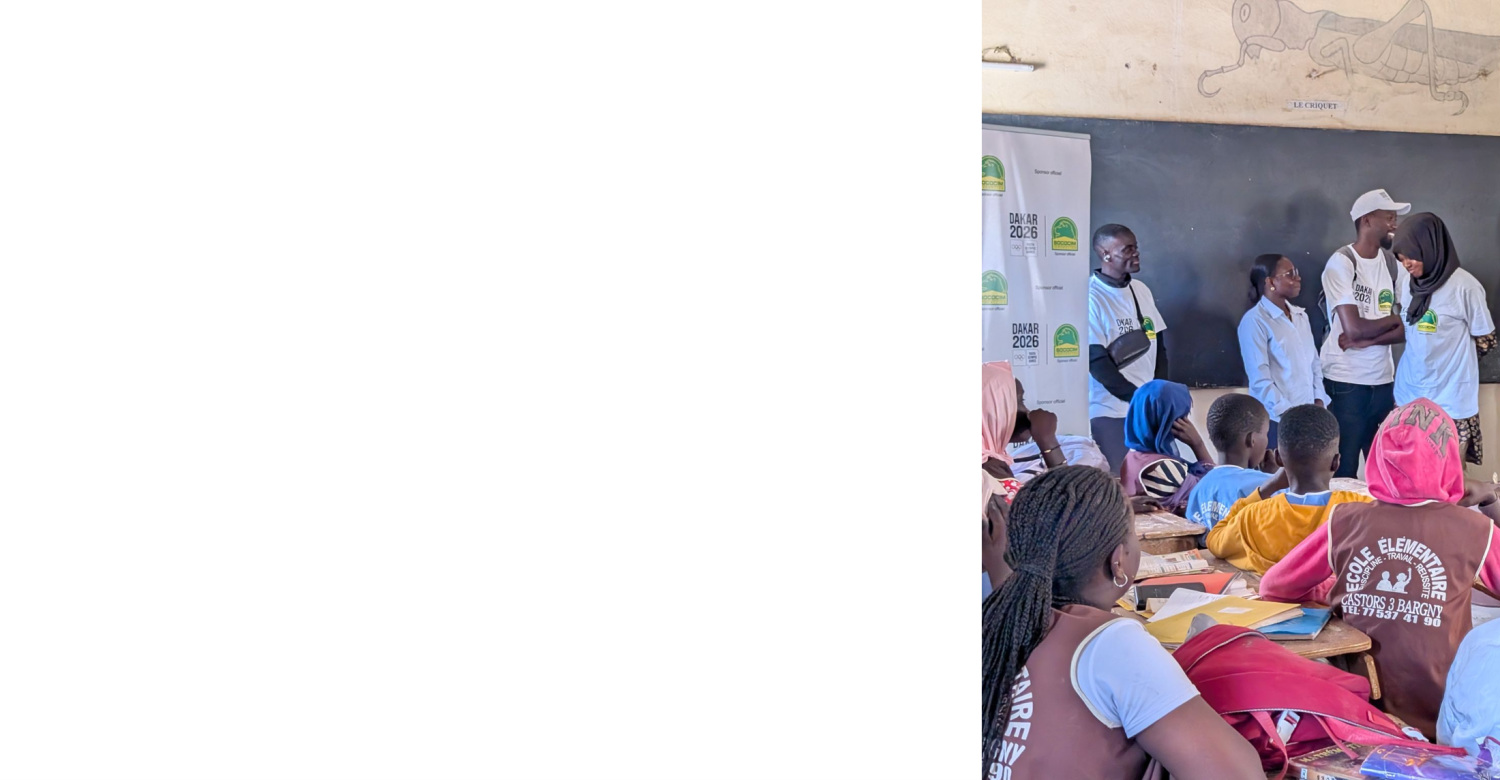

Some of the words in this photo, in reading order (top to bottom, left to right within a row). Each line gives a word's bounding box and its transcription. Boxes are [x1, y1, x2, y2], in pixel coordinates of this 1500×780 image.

[1304, 102, 1338, 110] CRIQUET
[1009, 212, 1038, 225] DAKAR
[1009, 225, 1038, 239] 2026
[1012, 323, 1039, 335] DAKAR
[1012, 335, 1039, 349] 2026
[1346, 546, 1375, 592] ECOLE
[1377, 536, 1448, 602] ÉLÉMENTAIRE
[1387, 552, 1413, 565] TRAVAIL
[1415, 563, 1431, 599] REUSSITE
[1341, 593, 1387, 610] CASTORS
[1388, 597, 1395, 611] 3
[1396, 598, 1443, 619] BARGNY
[1362, 607, 1375, 617] 77
[1375, 609, 1399, 620] 537
[1403, 613, 1418, 624] 41
[1423, 617, 1442, 627] 90
